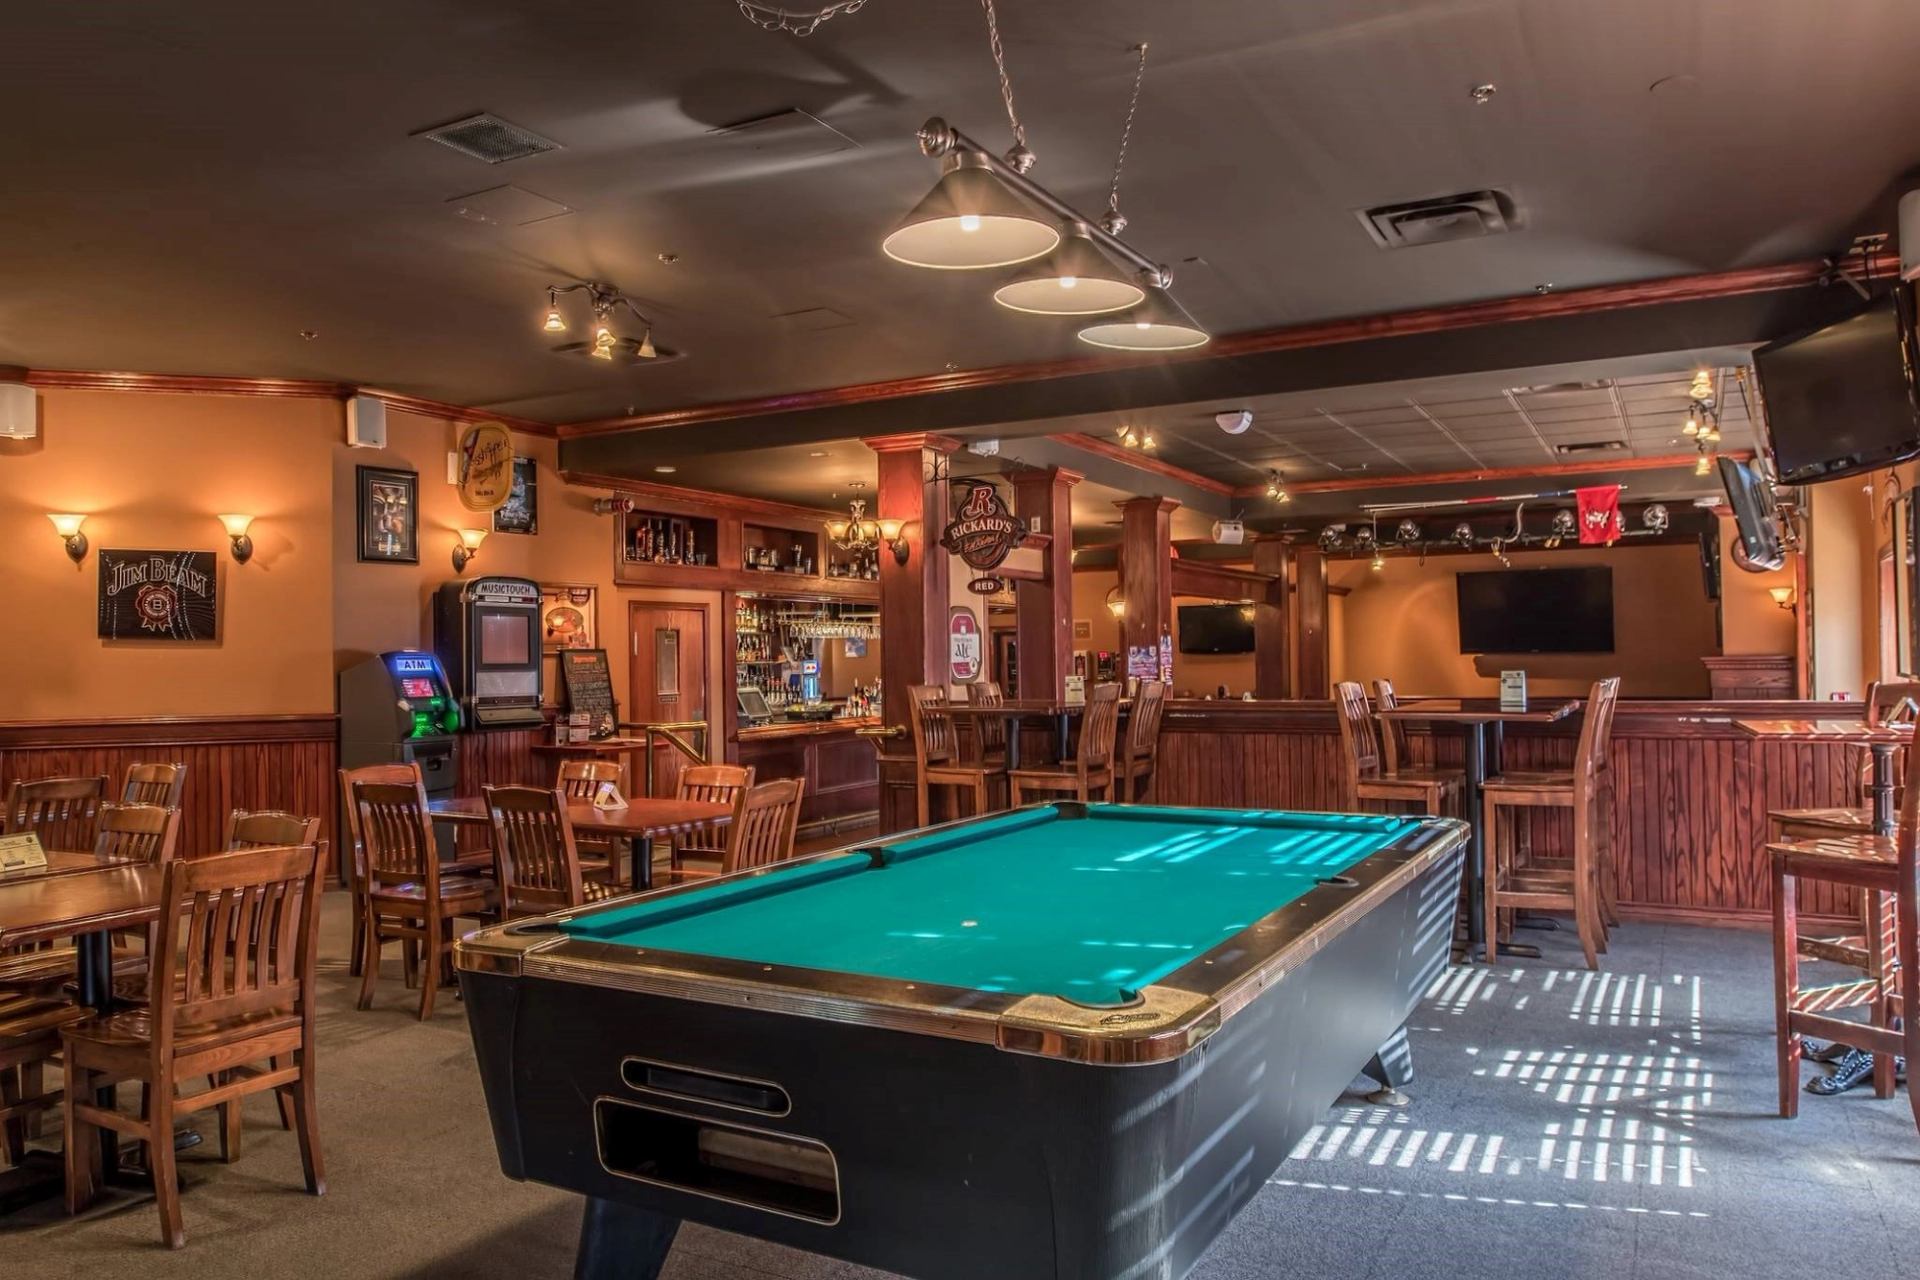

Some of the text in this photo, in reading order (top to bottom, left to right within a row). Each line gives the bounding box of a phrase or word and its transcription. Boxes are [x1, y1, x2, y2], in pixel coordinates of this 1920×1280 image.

[951, 519, 1013, 540] RICKARD'S
[106, 557, 208, 598] JIM BEAM
[481, 584, 531, 594] MUSICTOUCH
[975, 582, 994, 591] RED
[404, 660, 426, 669] ATM
